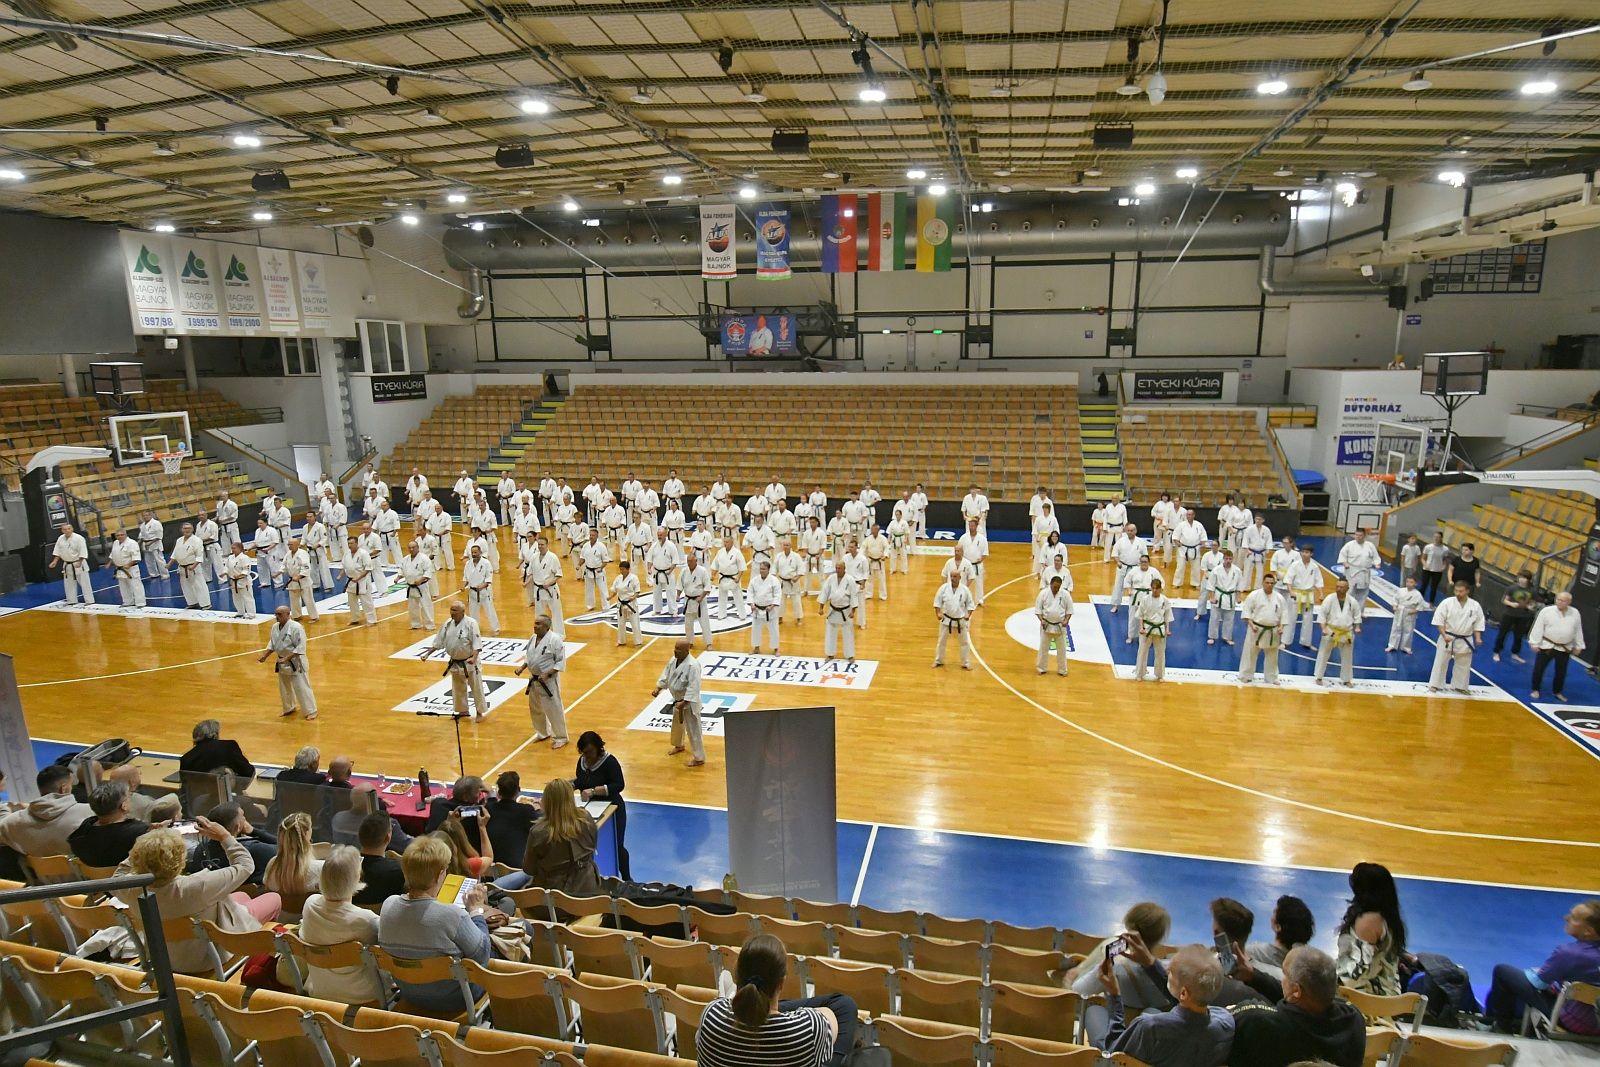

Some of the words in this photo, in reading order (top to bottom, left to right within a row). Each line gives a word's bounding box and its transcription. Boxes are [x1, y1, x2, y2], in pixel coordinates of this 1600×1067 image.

[303, 297, 328, 305] MAGYAR
[374, 381, 402, 391] ETYEKI
[1137, 379, 1180, 388] ETYEKI
[1182, 377, 1220, 388] KÚRIA
[1344, 403, 1402, 412] BÚTORHÁZ
[1482, 472, 1516, 480] SPALDING
[710, 654, 861, 674] FEHÉRVÁR
[703, 664, 815, 684] TRAVEL
